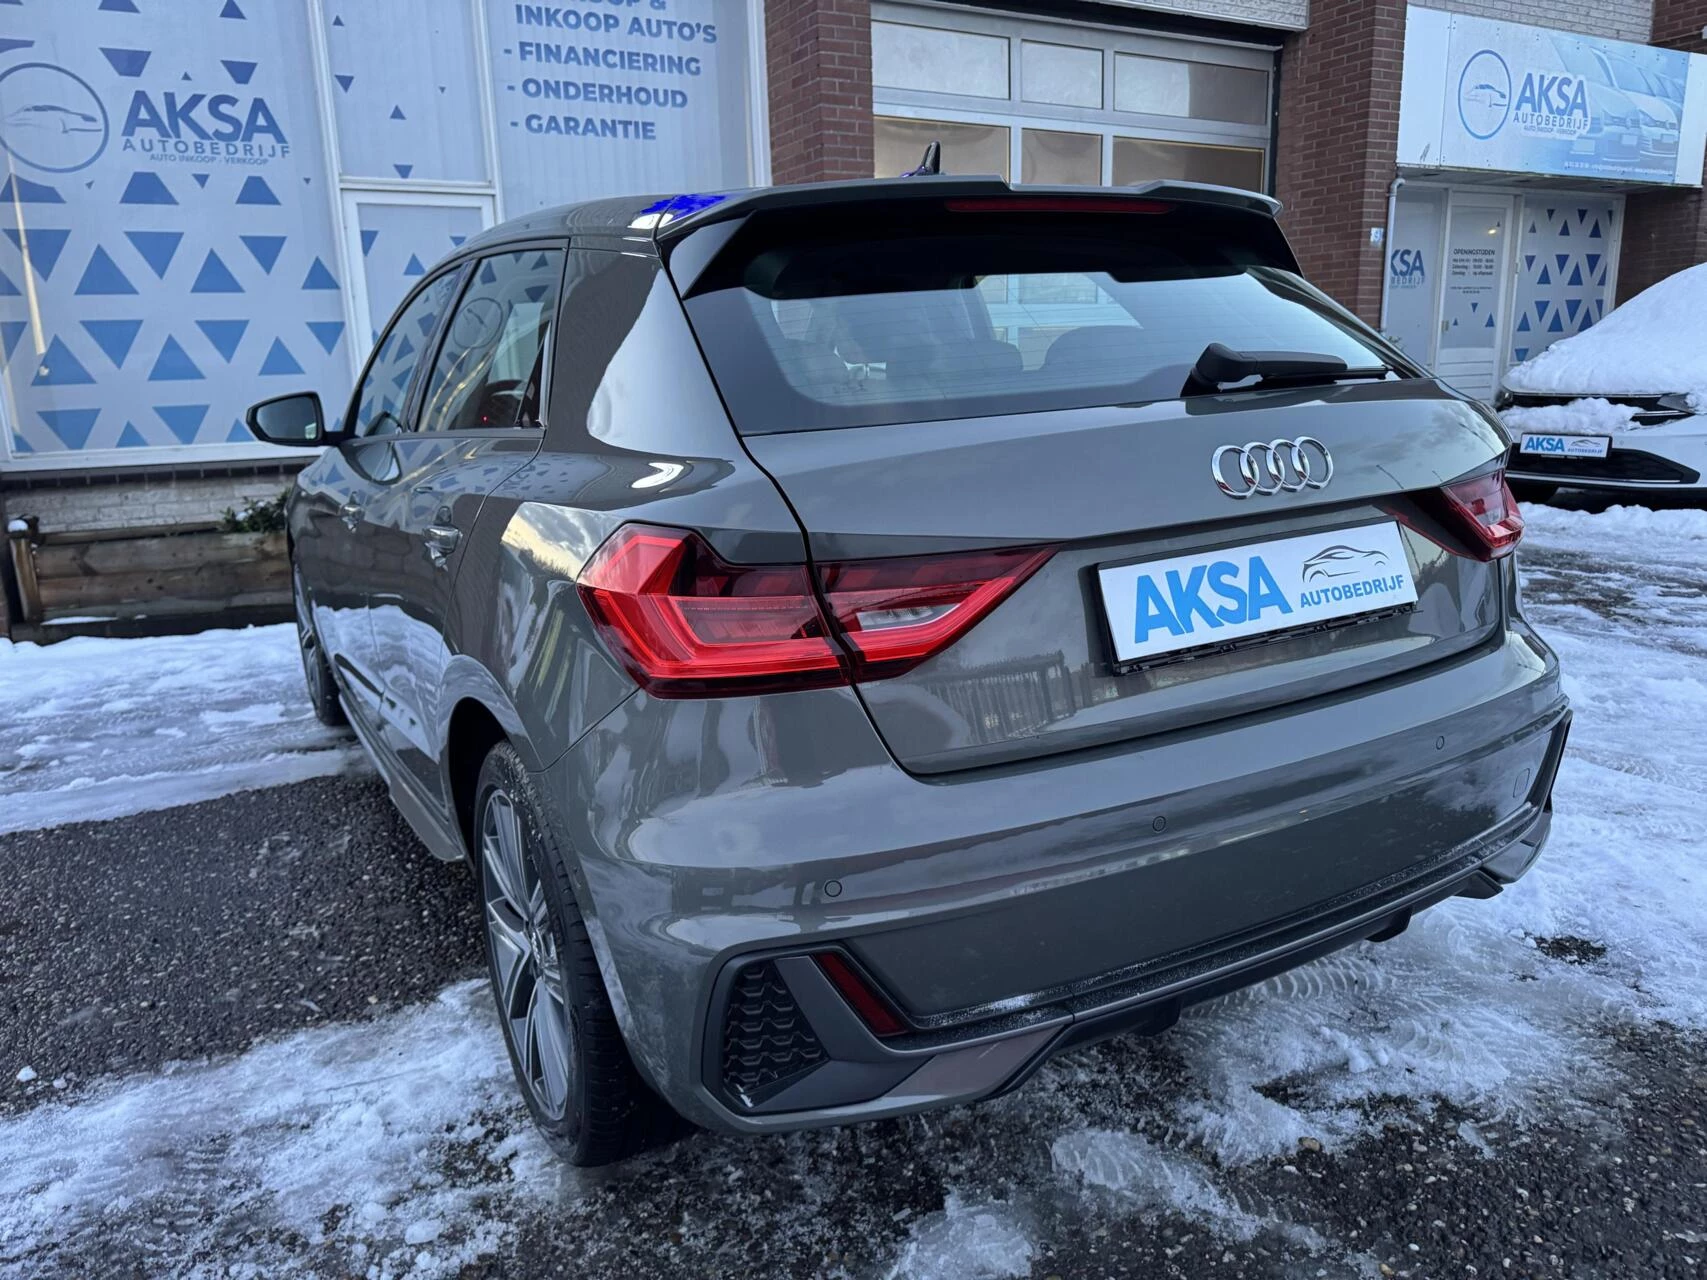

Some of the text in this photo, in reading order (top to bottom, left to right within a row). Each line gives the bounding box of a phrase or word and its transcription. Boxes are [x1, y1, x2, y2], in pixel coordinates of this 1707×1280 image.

[515, 4, 718, 44] INKOOP AUTO'S
[518, 41, 701, 76] FINANCIERING
[521, 78, 688, 108] ONDERHOUD
[1515, 72, 1590, 119] AKSA
[121, 90, 288, 144] AKSA
[525, 114, 656, 140] GARANTIE
[1513, 112, 1589, 130] AUTOBEDRIJF
[122, 138, 290, 158] AUTOBEDRIJF
[150, 153, 177, 162] AUTO
[1390, 249, 1425, 276] KSA
[1524, 436, 1565, 452] AKSA
[1134, 555, 1293, 644] AKSA
[1300, 574, 1405, 608] AUTOBEDRIJF
